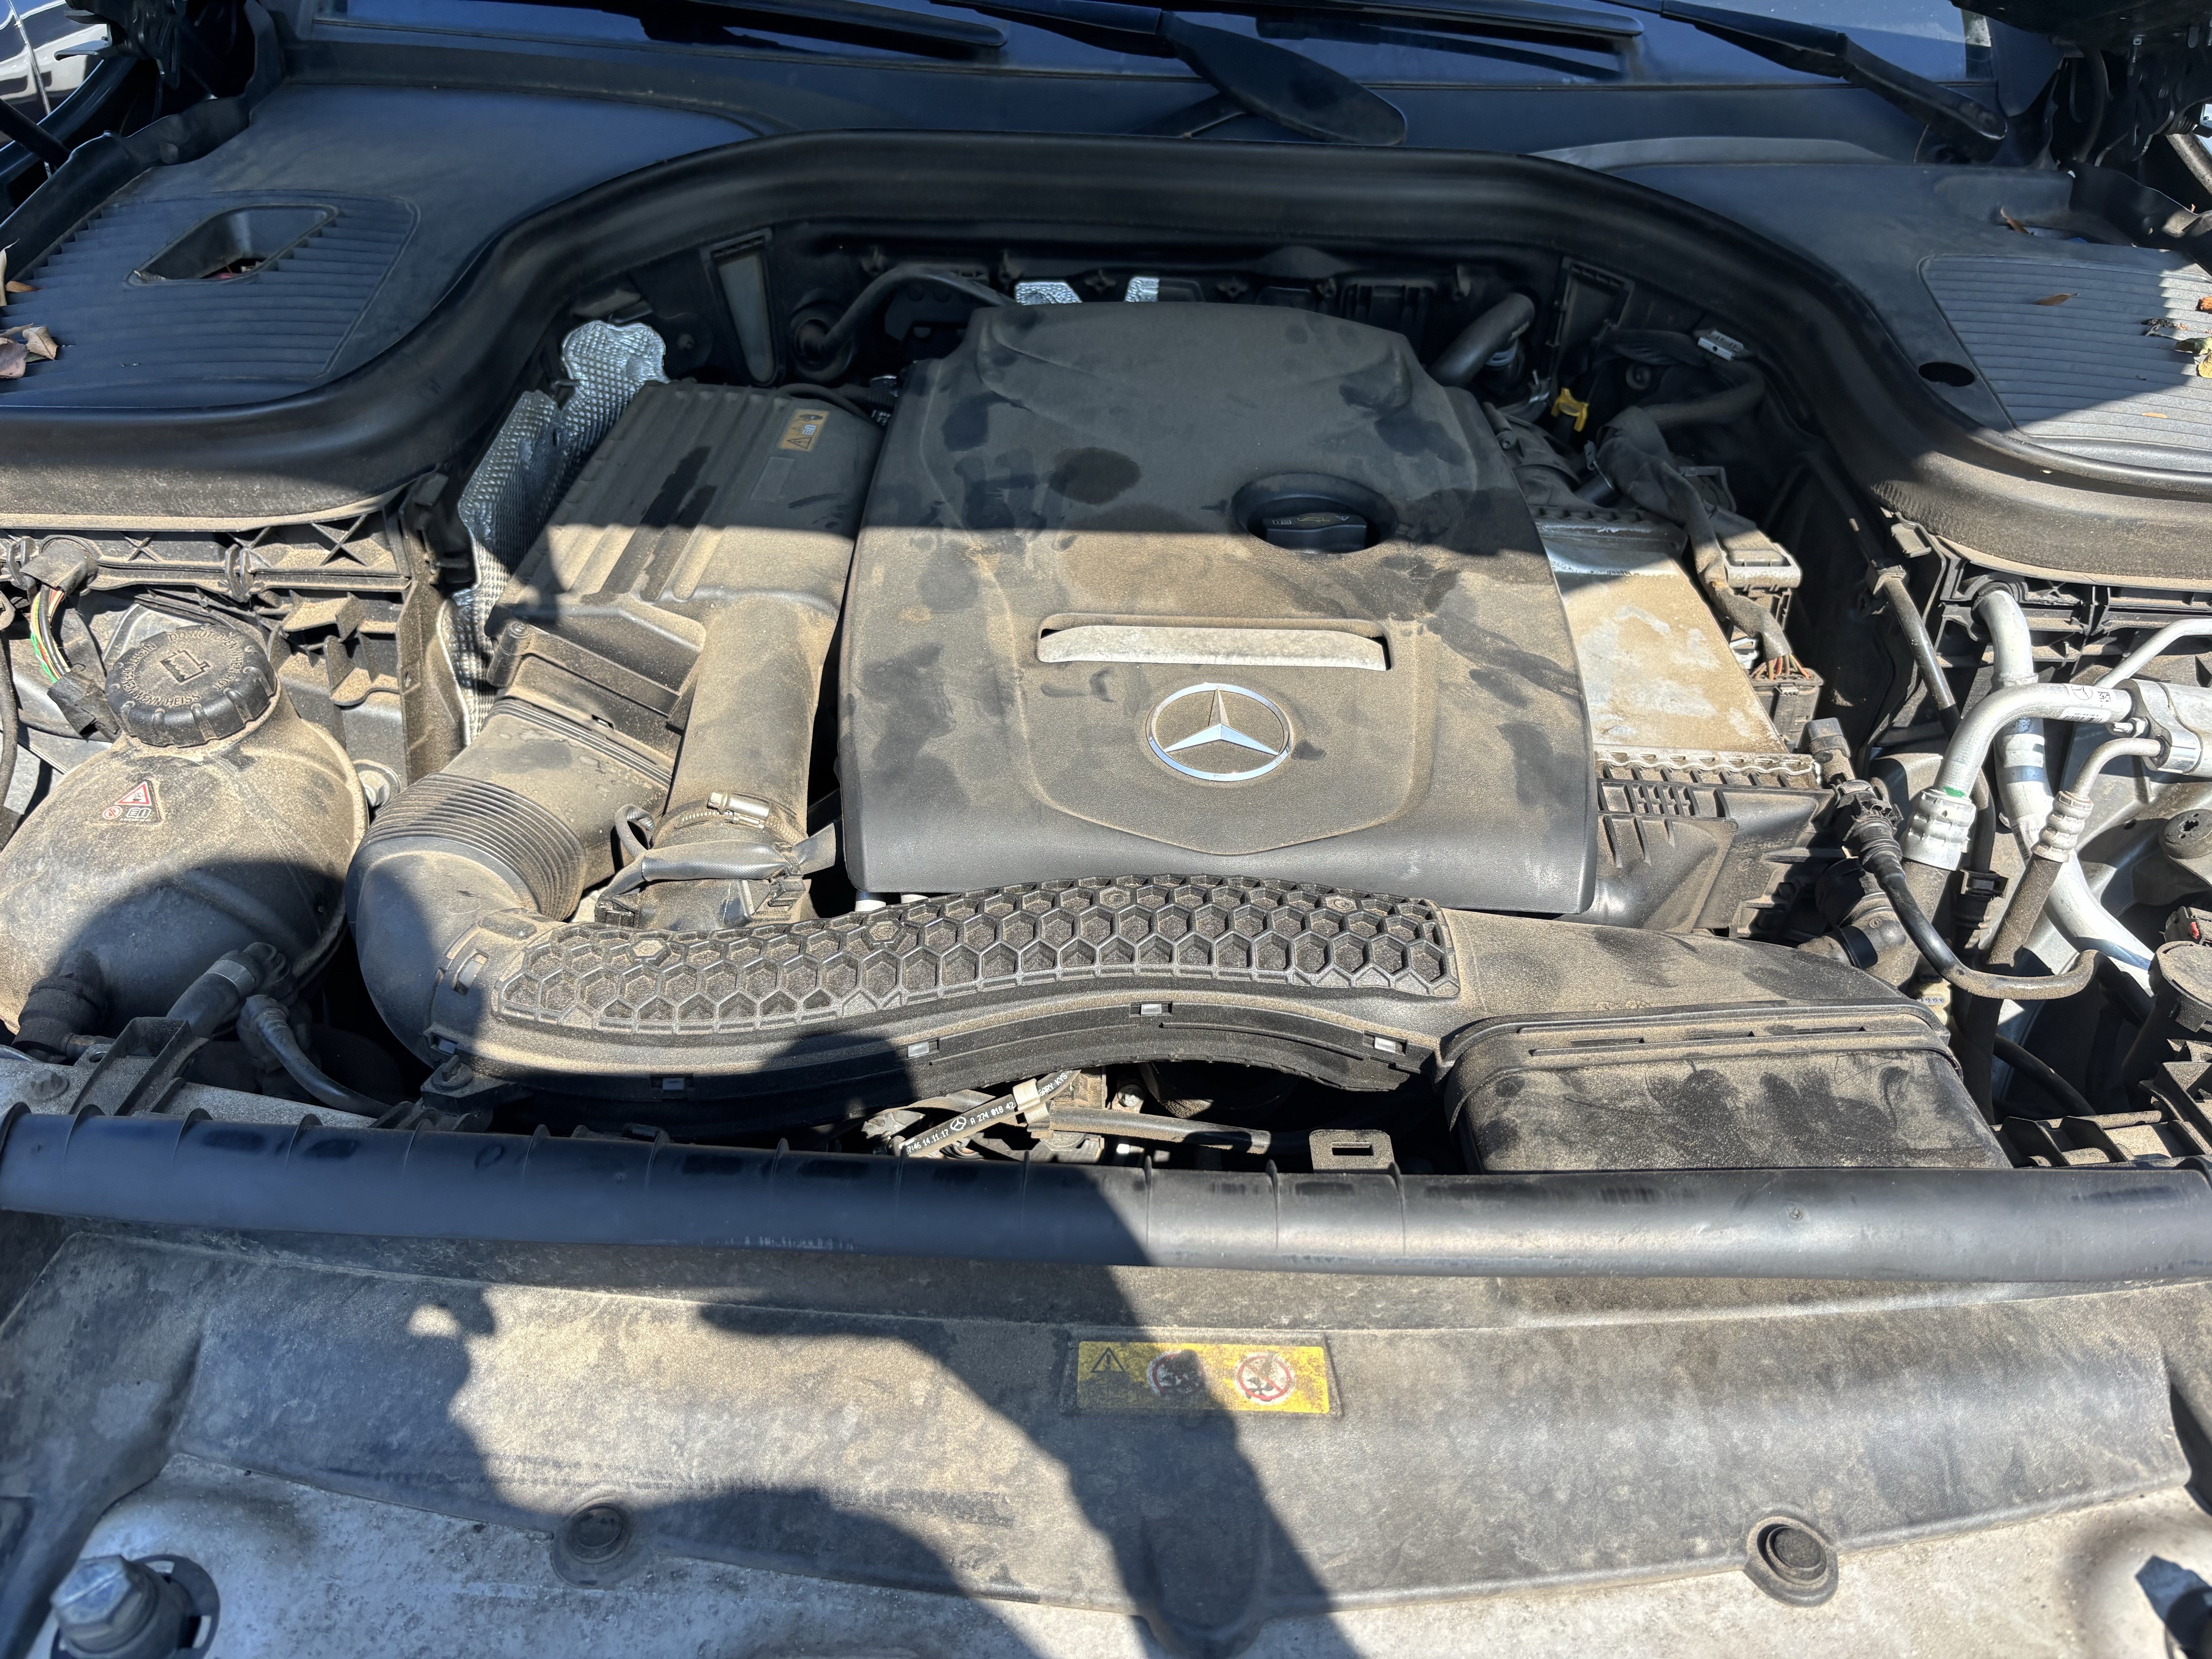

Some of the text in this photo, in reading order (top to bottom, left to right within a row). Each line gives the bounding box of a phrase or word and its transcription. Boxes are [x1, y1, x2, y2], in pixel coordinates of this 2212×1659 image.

[169, 632, 186, 641] DO
[191, 630, 215, 639] NOT
[213, 633, 240, 650] OPEN
[229, 648, 245, 674] WHEN
[132, 690, 165, 706] WENN
[164, 694, 202, 707] HEISS
[922, 1128, 949, 1147] 14.11.17
[970, 1117, 976, 1125] A
[977, 1111, 989, 1122] 274
[1006, 1101, 1015, 1110] 42
